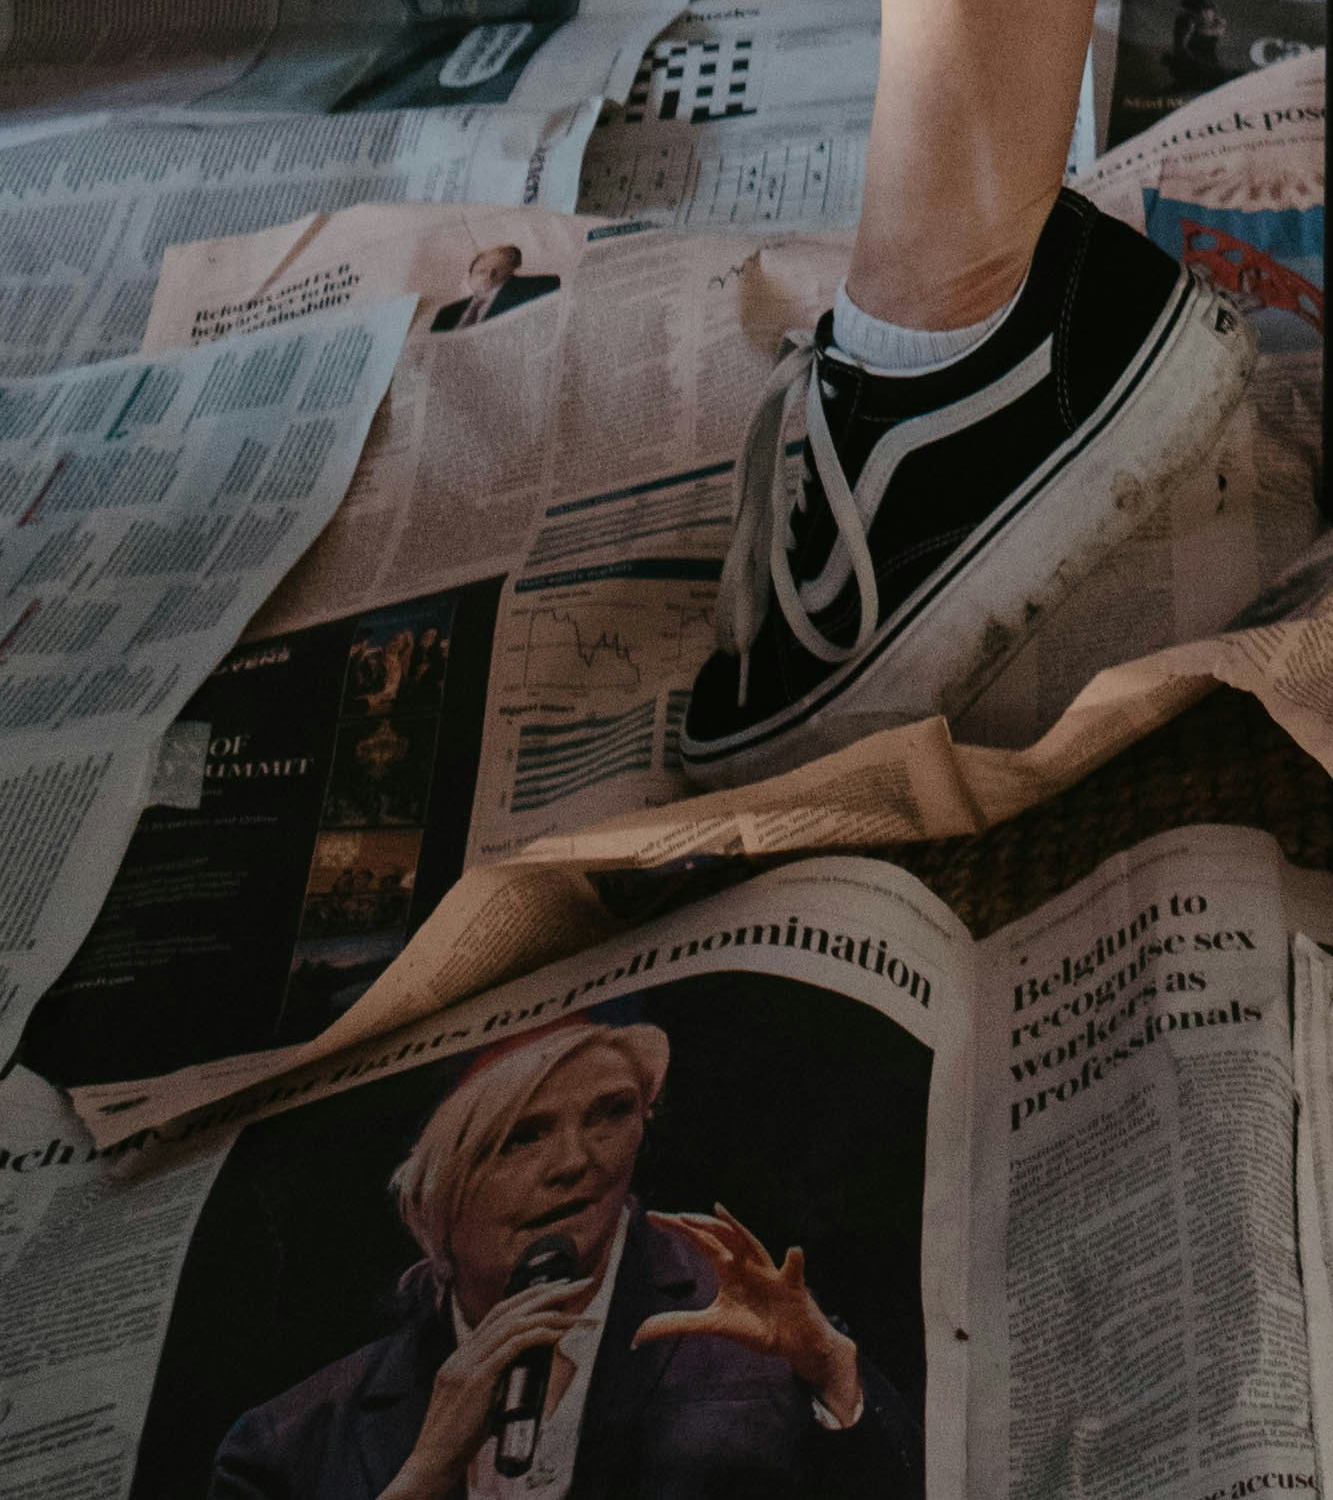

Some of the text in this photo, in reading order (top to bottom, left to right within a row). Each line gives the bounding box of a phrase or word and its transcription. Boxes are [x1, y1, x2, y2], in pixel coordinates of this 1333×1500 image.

[553, 914, 934, 1011] poll nomination
[1012, 929, 1256, 1049] recognise sex
[1013, 893, 1208, 1013] Belgium to
[1009, 971, 1207, 1083] workers as
[1009, 1000, 1263, 1132] professionals
